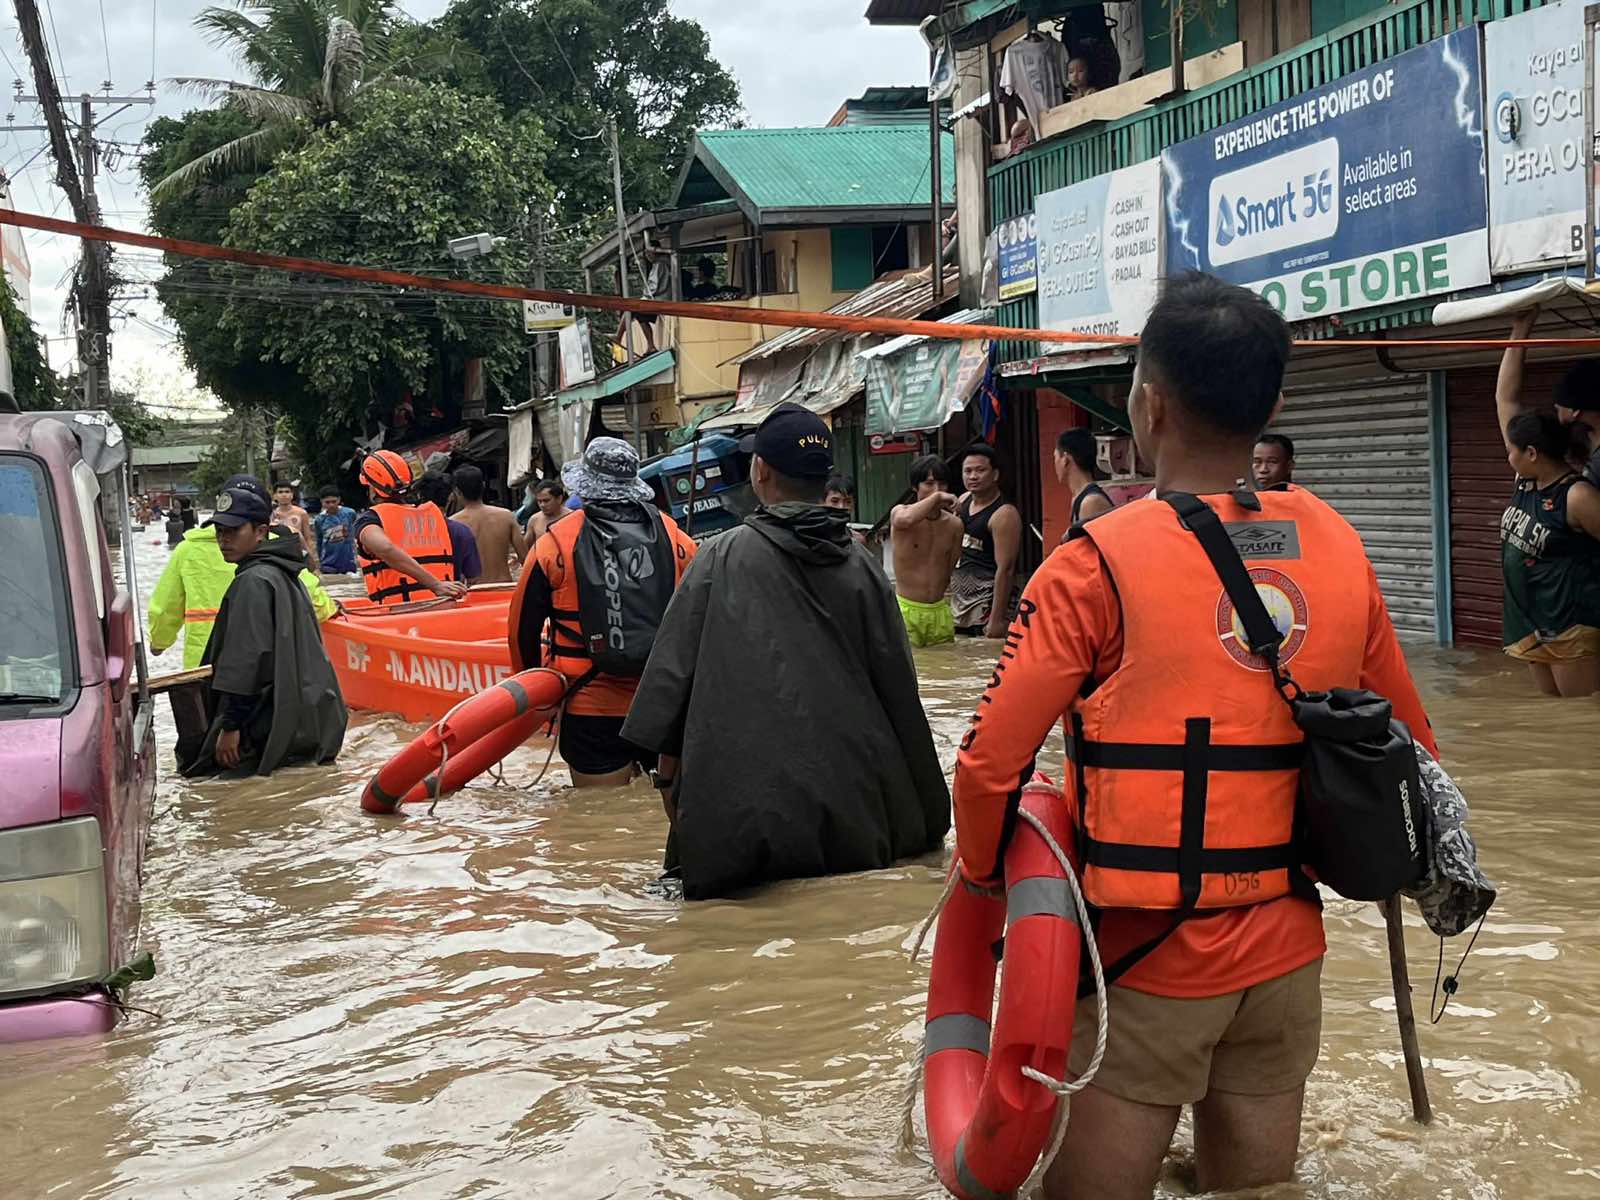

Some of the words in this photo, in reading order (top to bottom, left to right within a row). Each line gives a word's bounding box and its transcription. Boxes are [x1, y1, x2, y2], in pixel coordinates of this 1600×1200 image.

[1528, 50, 1566, 78] Kaya
[1215, 110, 1288, 160] EXPERIENCE
[1290, 101, 1317, 132] THE
[1319, 80, 1370, 121] POWER
[1372, 69, 1394, 100] OF
[1344, 149, 1398, 186] Available
[1400, 147, 1412, 169] in
[1504, 144, 1556, 185] PERA
[1115, 198, 1134, 215] CASH
[1135, 197, 1143, 210] IN
[1237, 181, 1297, 236] Smart
[1303, 168, 1332, 218] 5G
[1346, 187, 1382, 214] select
[1385, 177, 1417, 203] areas
[1115, 221, 1134, 238] CASH
[1135, 216, 1149, 233] OUT
[1115, 243, 1139, 260] BAYAD
[1140, 238, 1156, 255] BILLS
[1301, 243, 1450, 313] STORE
